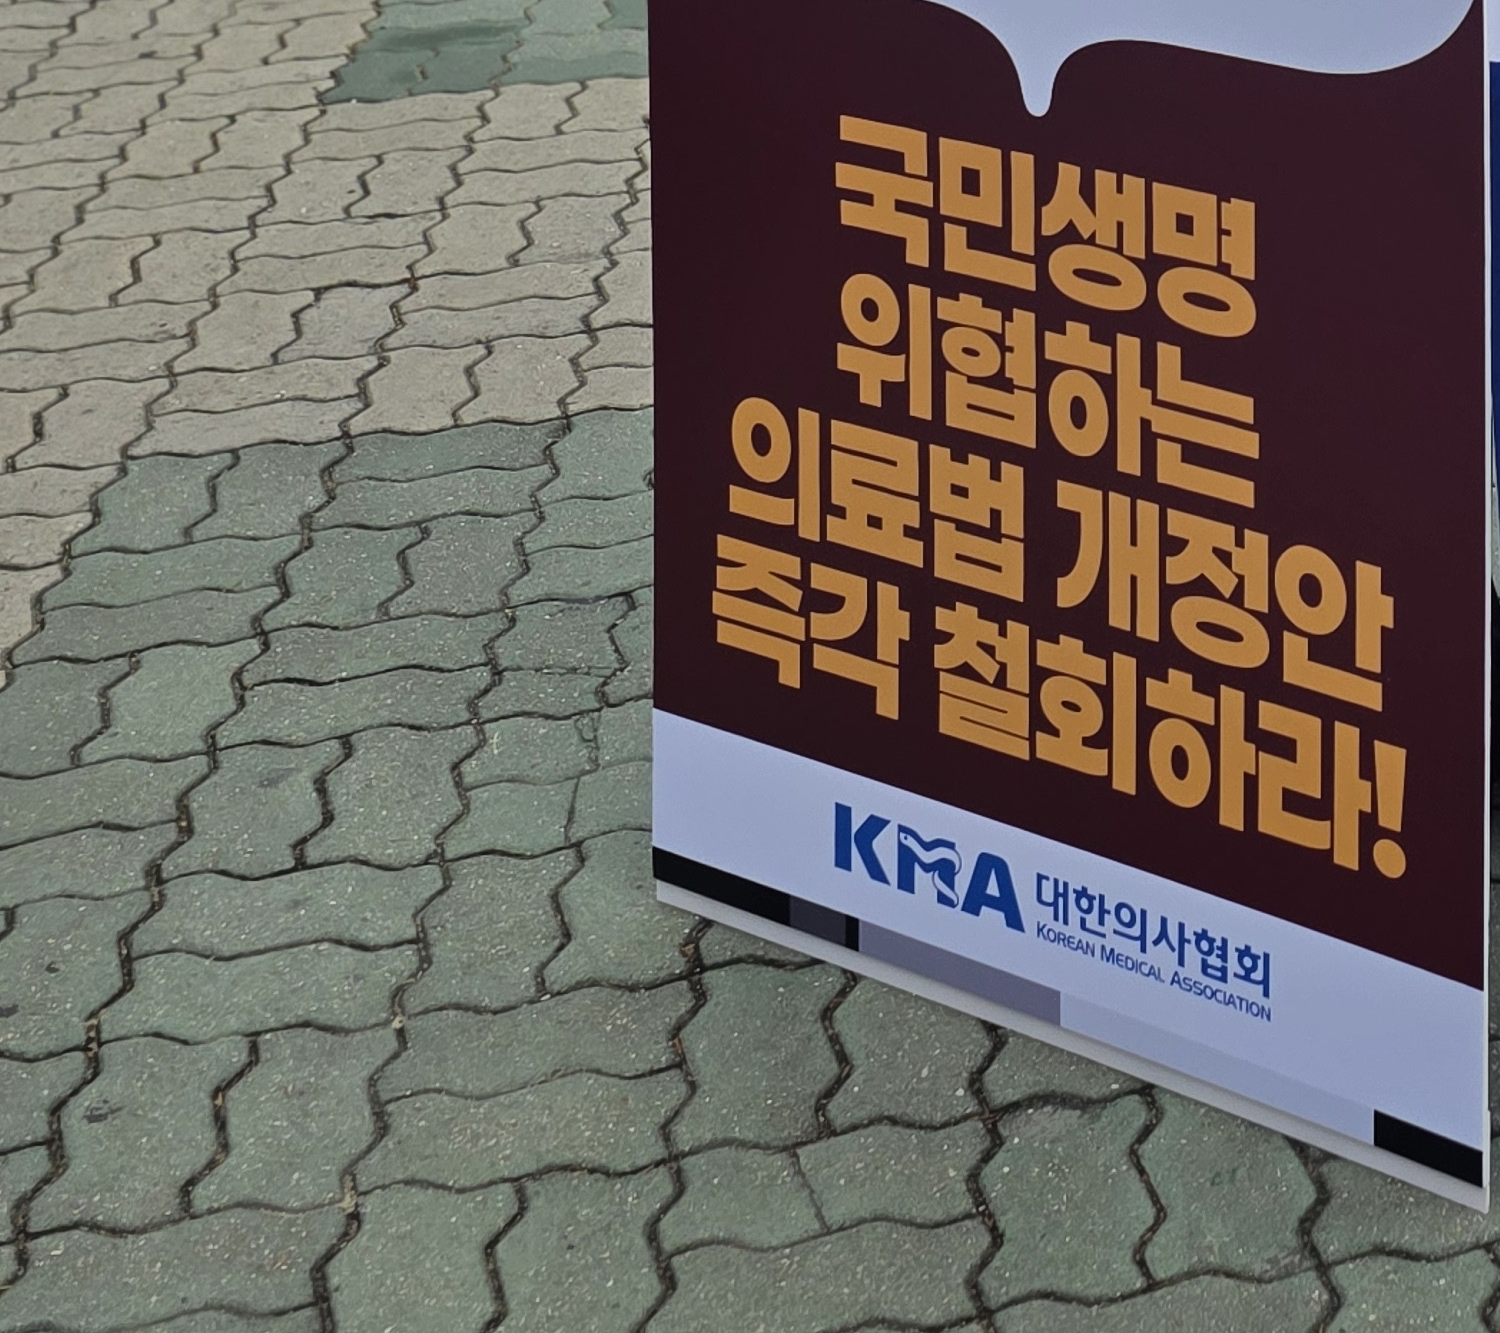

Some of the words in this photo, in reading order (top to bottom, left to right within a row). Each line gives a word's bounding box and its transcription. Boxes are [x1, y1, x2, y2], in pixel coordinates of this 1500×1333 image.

[836, 115, 1256, 337] 국민생명
[837, 274, 1259, 508] 위협하는
[730, 397, 1024, 602] 의료법
[1057, 480, 1393, 711] 개정안
[713, 534, 910, 720] 즉각
[934, 602, 1406, 878] 철회하라!
[834, 802, 1025, 933] KMA
[1037, 873, 1270, 999] 대한의사협회
[1037, 921, 1095, 957] KOREAN
[1101, 944, 1165, 983] MEDICAL
[1170, 971, 1271, 1022] ASSOCIATION
